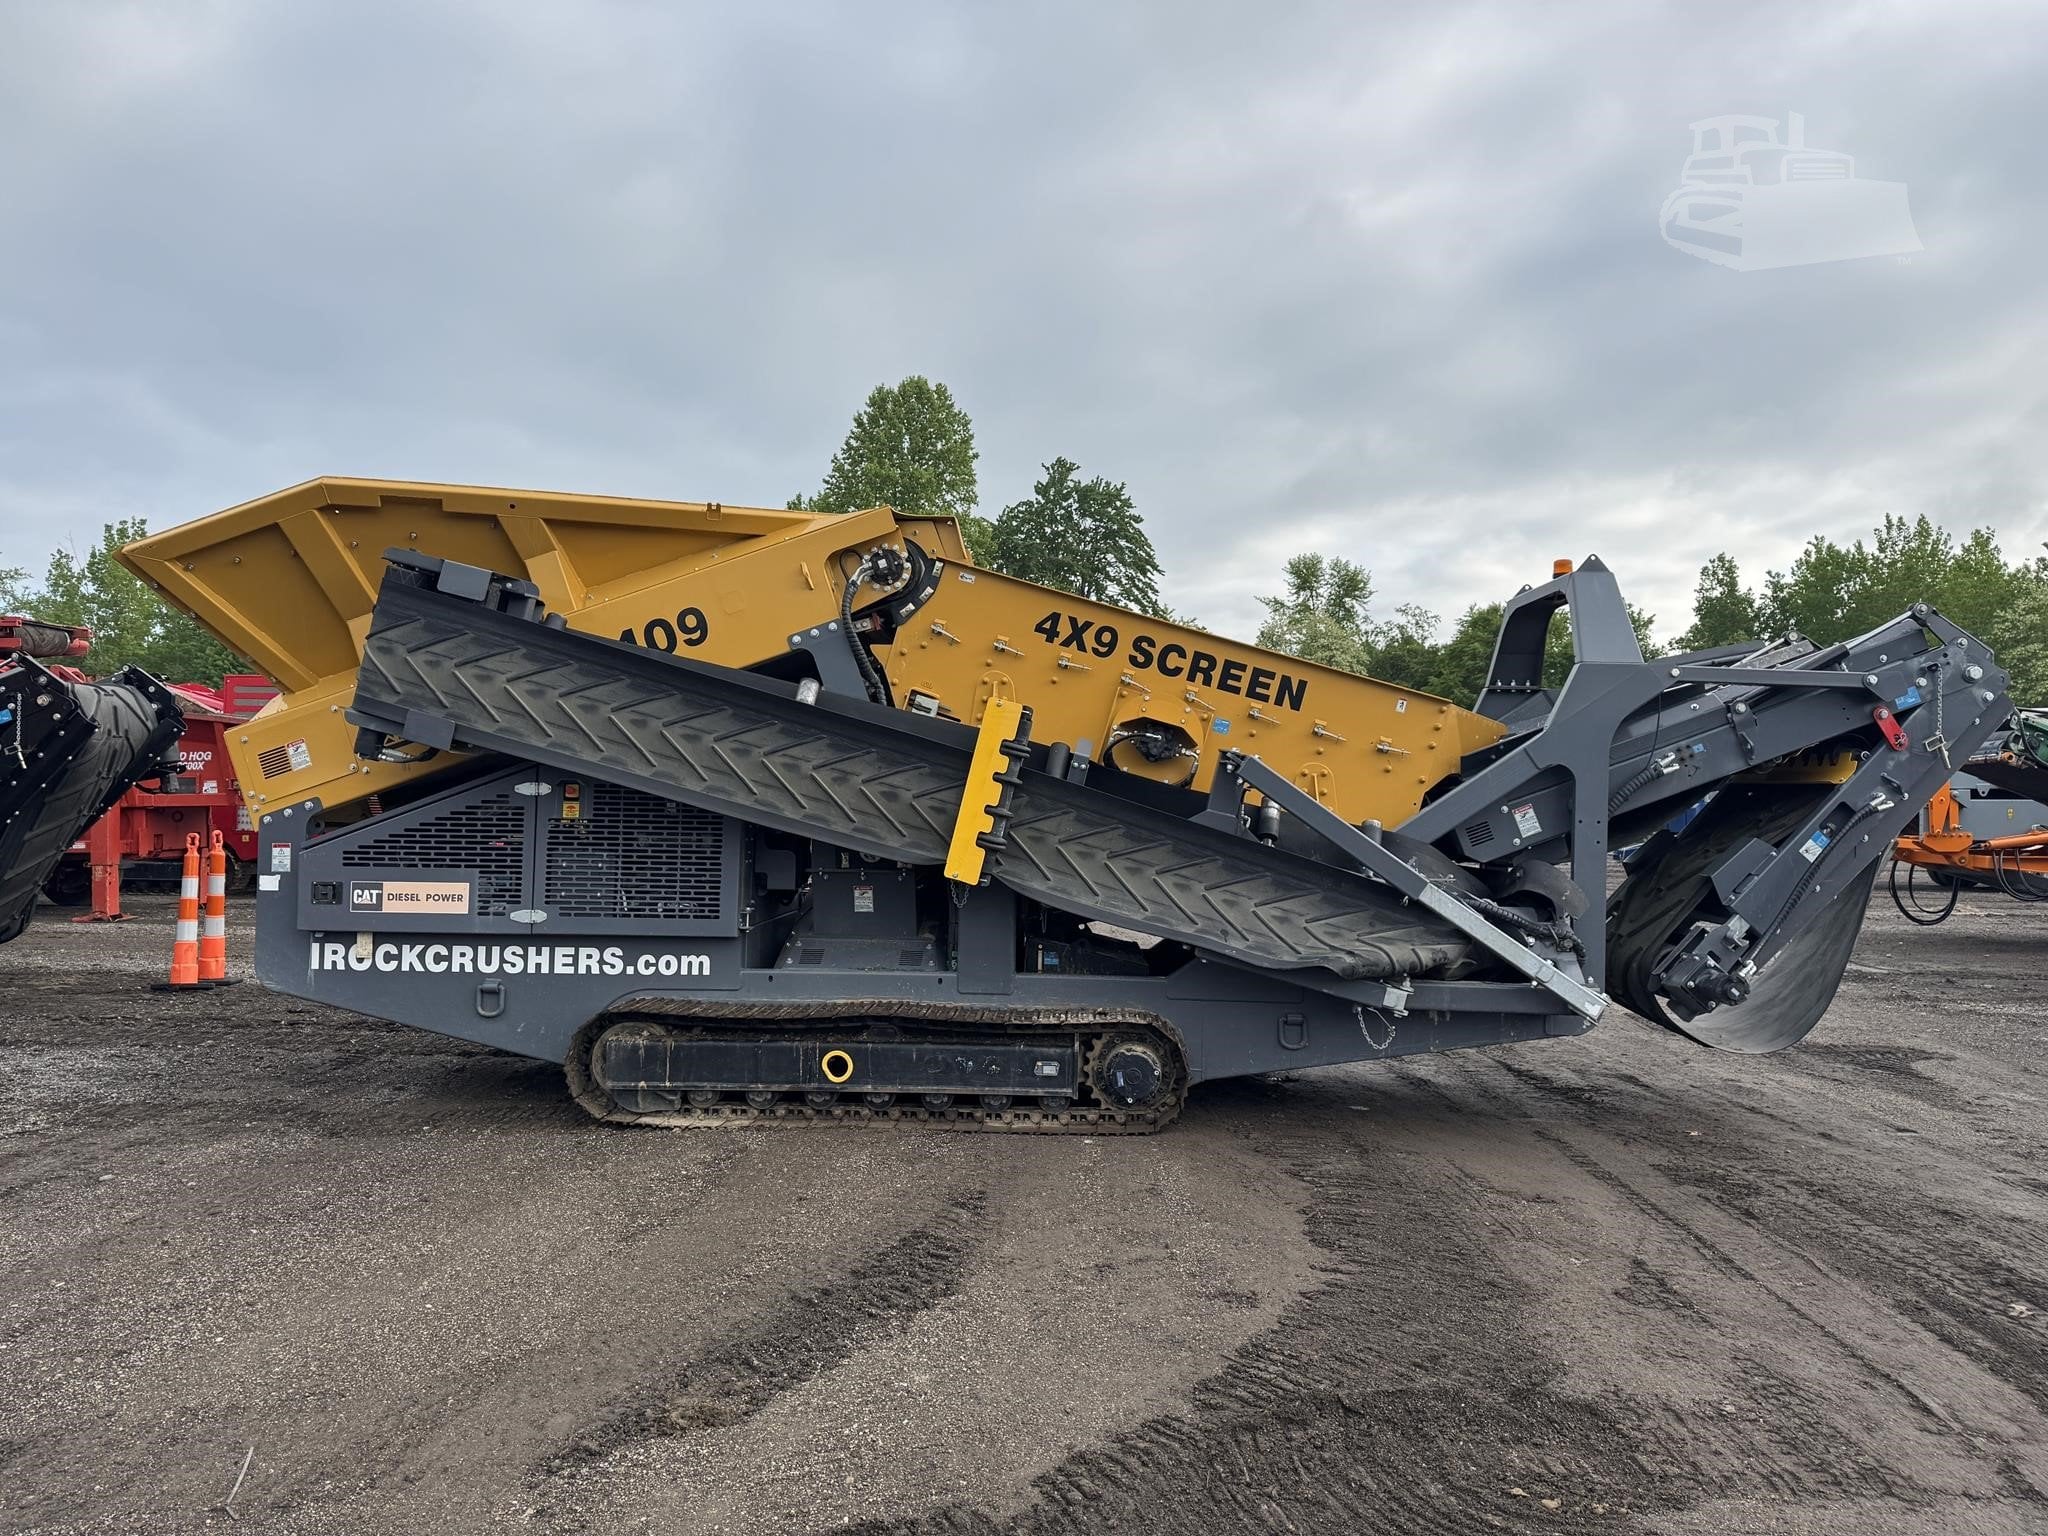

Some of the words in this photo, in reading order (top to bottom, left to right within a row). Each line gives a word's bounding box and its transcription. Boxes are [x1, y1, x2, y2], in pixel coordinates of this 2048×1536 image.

[1034, 611, 1119, 658] 4X9
[1128, 635, 1308, 712] SCREEN
[188, 751, 212, 761] HOG
[353, 889, 382, 905] CAT
[387, 892, 421, 901] DIESEL
[425, 893, 464, 903] POWER
[310, 942, 711, 976] IROCKCRUSHERS.com
